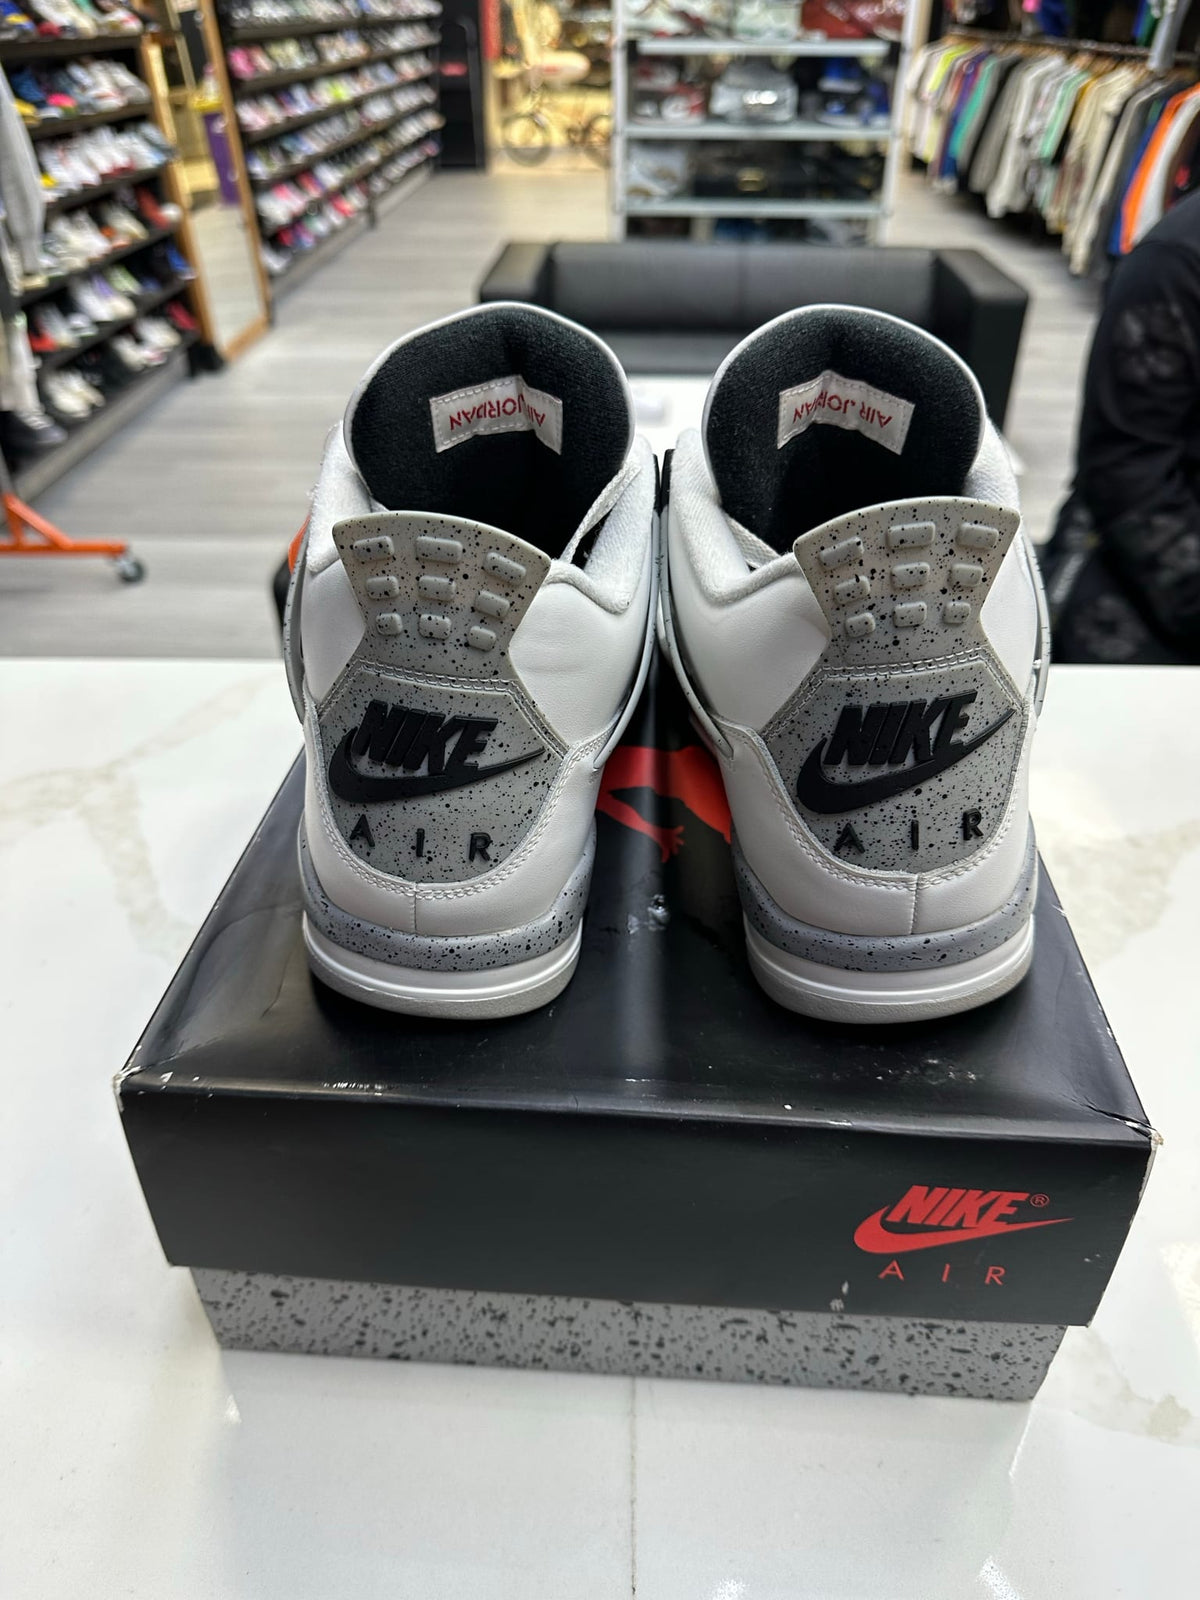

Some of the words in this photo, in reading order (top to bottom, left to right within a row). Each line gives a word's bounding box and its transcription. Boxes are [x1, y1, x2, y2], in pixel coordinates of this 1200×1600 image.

[449, 393, 524, 430] JORDAN
[859, 402, 892, 428] AIR
[352, 699, 498, 775] NIKE
[822, 689, 978, 766] NIKE
[350, 814, 493, 862] AIR
[833, 808, 984, 853] AIR
[879, 1259, 1006, 1286] AIR
